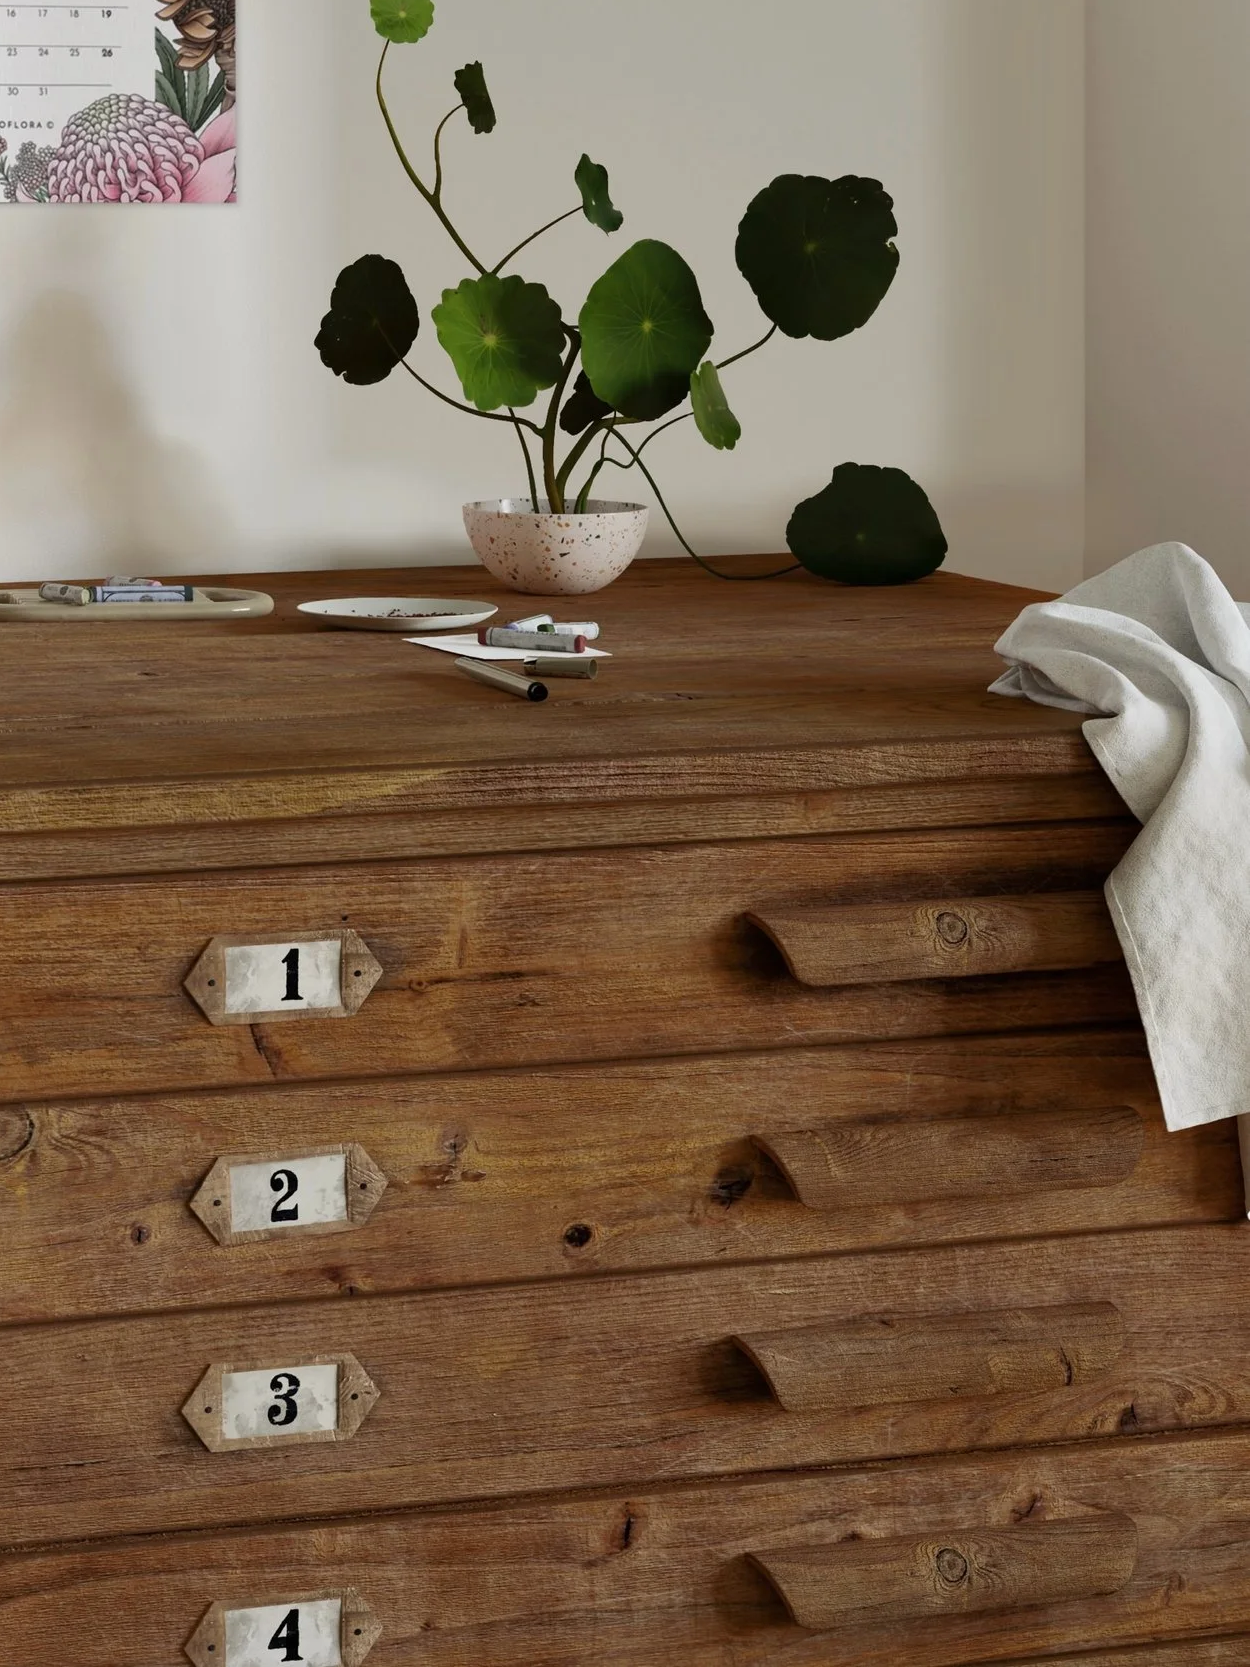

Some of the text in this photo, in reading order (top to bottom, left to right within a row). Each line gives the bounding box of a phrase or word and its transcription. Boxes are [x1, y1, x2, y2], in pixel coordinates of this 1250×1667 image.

[6, 8, 17, 18] 16
[37, 8, 48, 18] 17
[69, 9, 80, 19] 18
[101, 8, 113, 19] 19
[101, 47, 114, 58] 26
[38, 86, 49, 97] 31
[281, 948, 304, 1001] 1
[270, 1169, 299, 1223] 2
[267, 1372, 301, 1426] 3
[267, 1608, 304, 1663] 4
